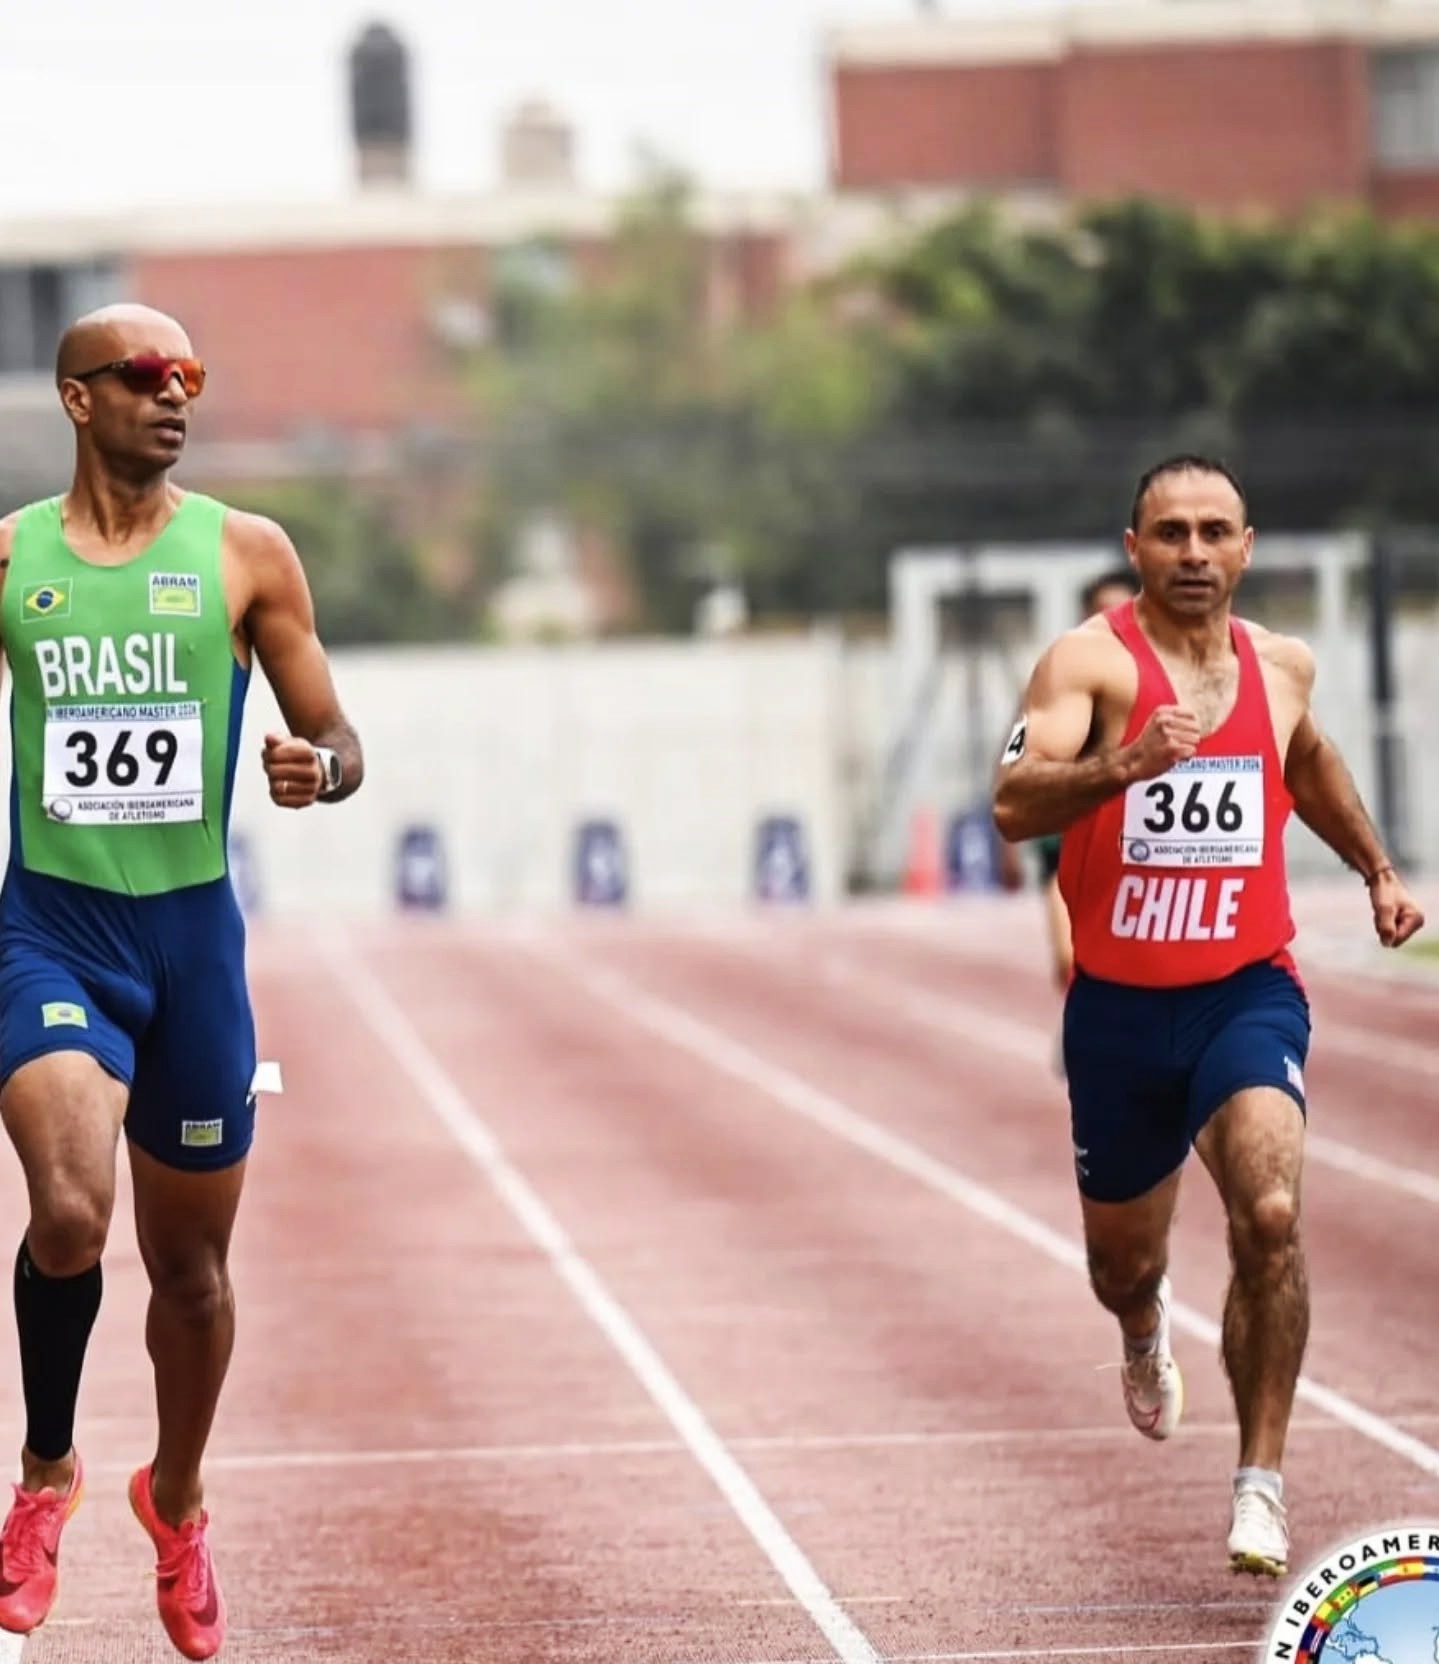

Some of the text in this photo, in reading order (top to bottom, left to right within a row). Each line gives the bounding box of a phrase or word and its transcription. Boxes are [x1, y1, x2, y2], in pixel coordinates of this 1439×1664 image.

[152, 575, 197, 589] ABRAM
[35, 632, 187, 697] BRASIL
[55, 705, 137, 719] IBEROAMERICANO
[139, 702, 176, 717] MASTER
[1008, 726, 1025, 754] 4
[65, 730, 178, 787] 369
[109, 809, 165, 821] DE ATLETISMO
[127, 799, 194, 810] IBEROAMERICANA
[1144, 781, 1243, 833] 366
[1111, 875, 1245, 941] CHILE
